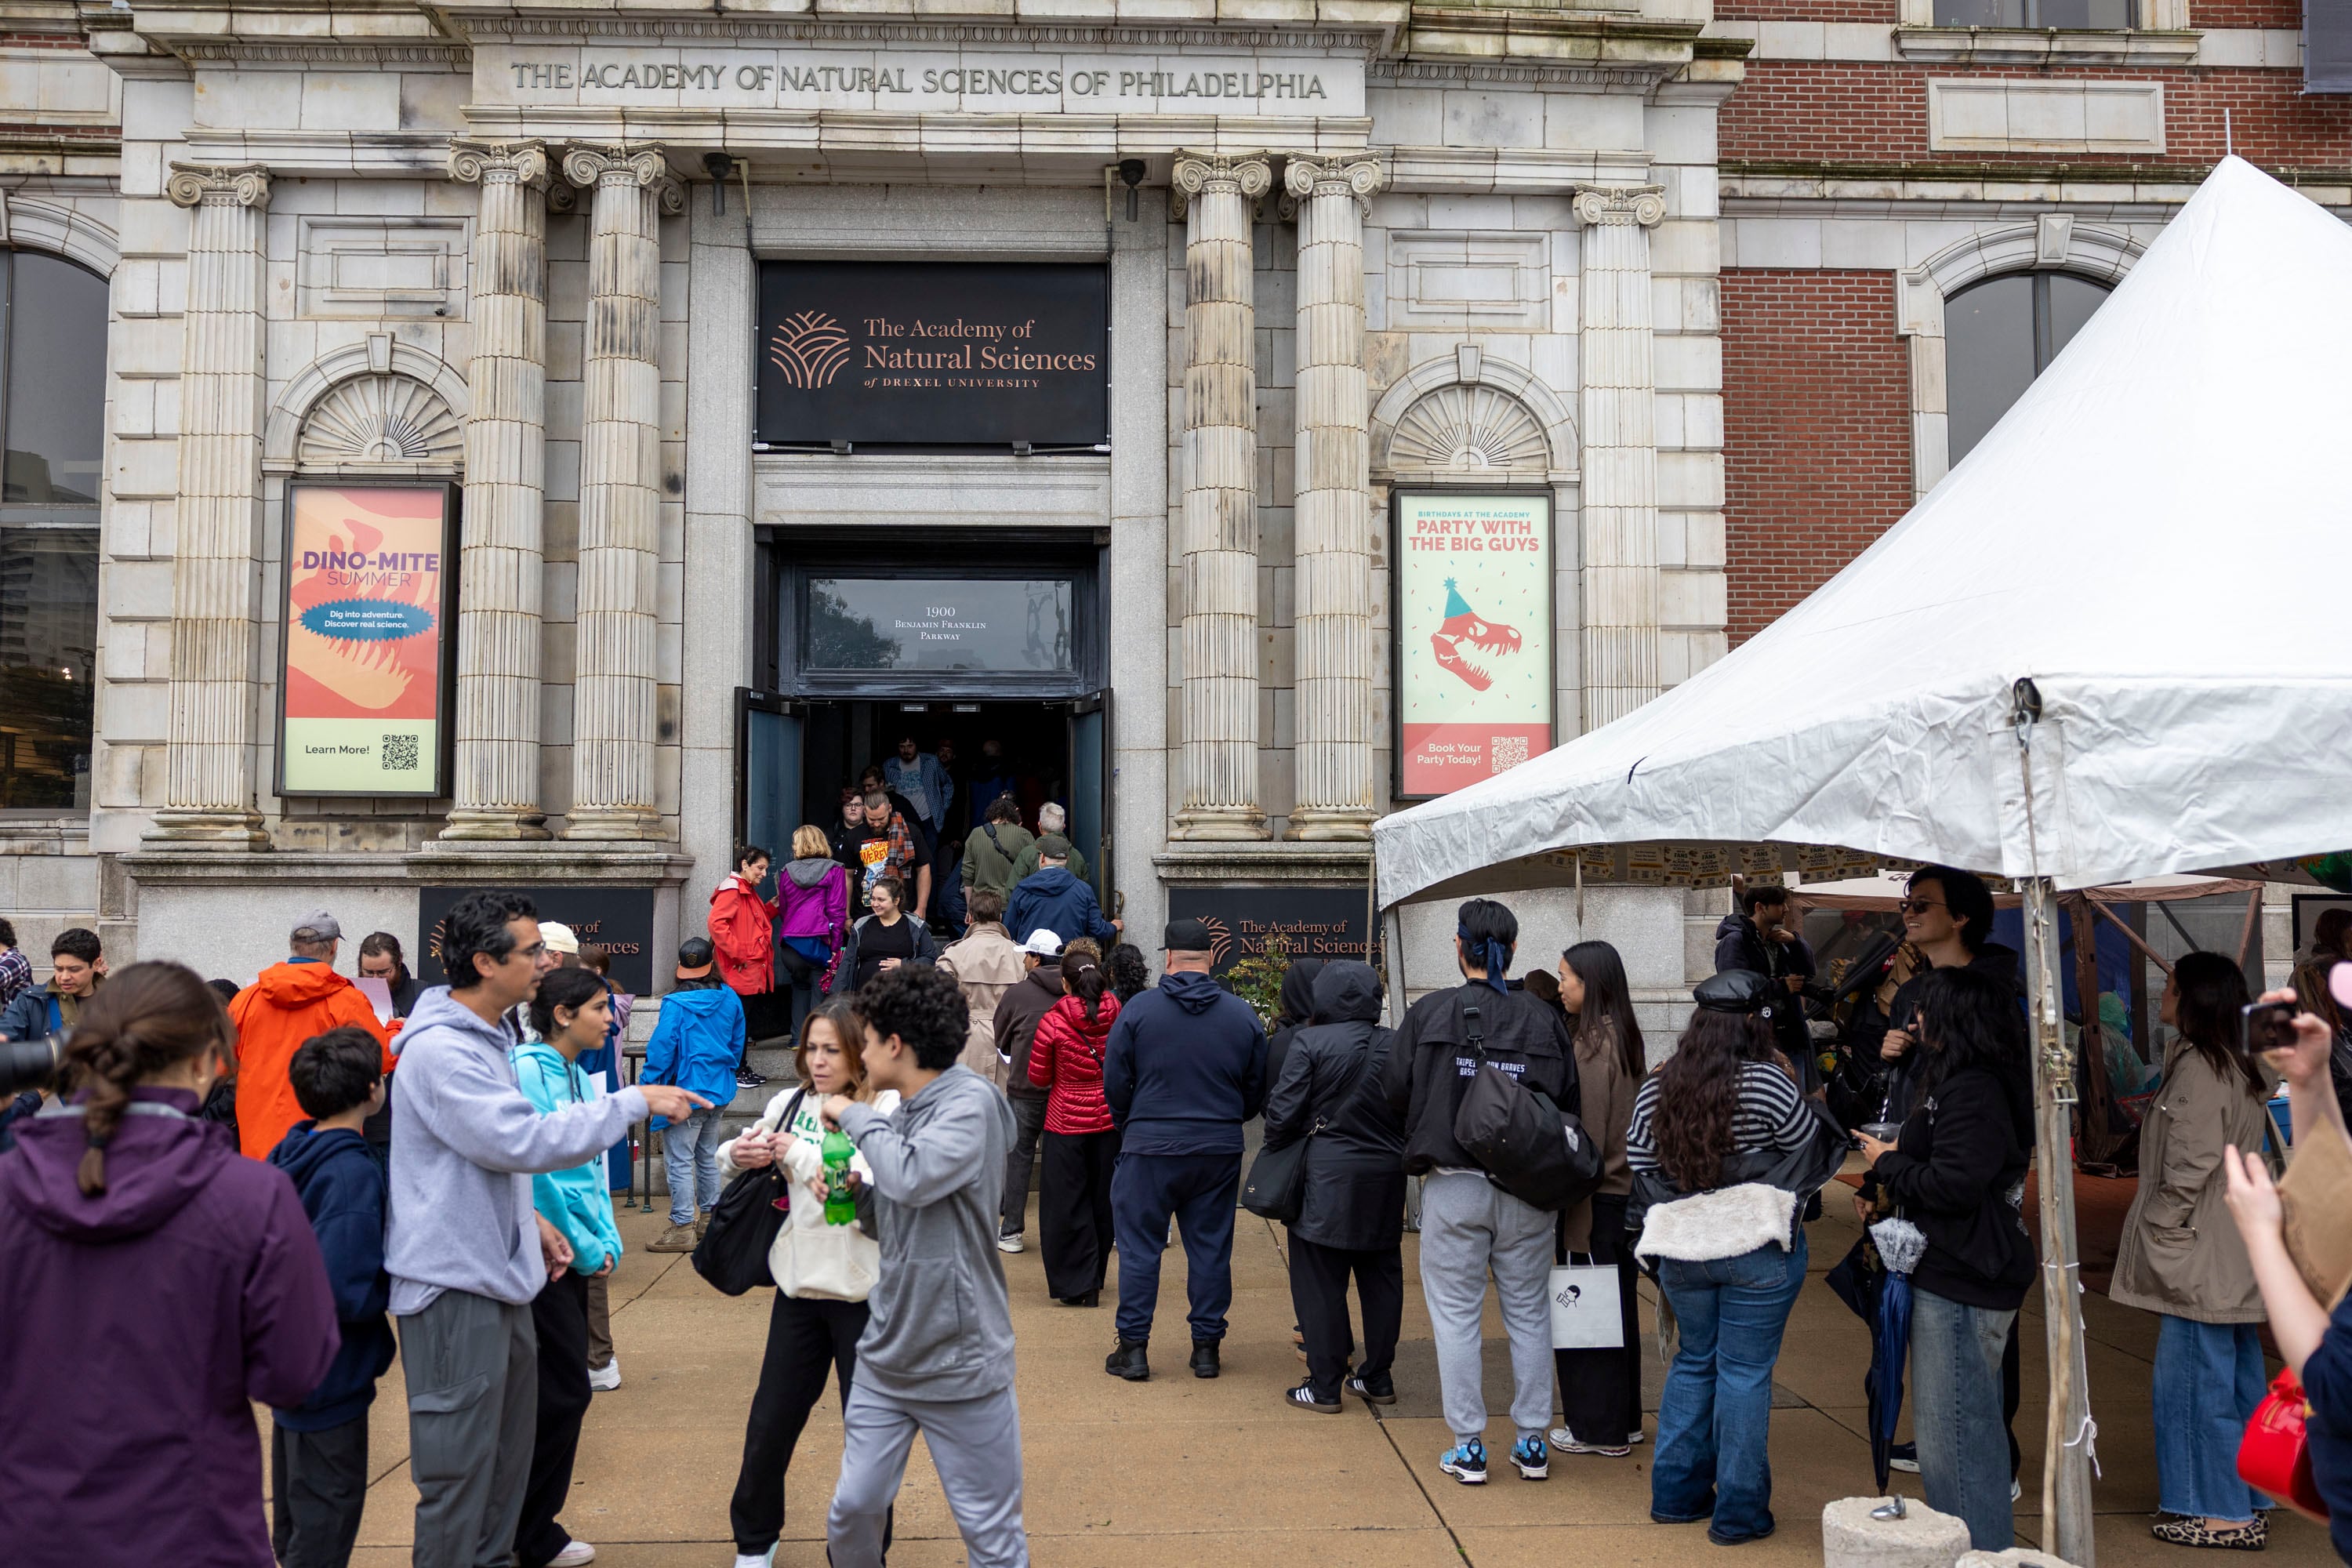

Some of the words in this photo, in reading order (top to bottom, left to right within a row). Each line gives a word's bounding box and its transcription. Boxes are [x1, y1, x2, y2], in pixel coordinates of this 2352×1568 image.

[510, 63, 573, 89] THE
[580, 63, 726, 89] ACADEMY
[735, 64, 775, 90] OF
[780, 66, 913, 93] NATURAL
[922, 68, 1062, 94] SCIENCES
[1070, 70, 1110, 96] OF
[1120, 71, 1327, 99] PHILADELPHIA
[864, 318, 904, 337] The
[909, 318, 1007, 343] Academy
[1011, 319, 1035, 338] of
[864, 344, 972, 369] Natural
[981, 346, 1095, 371] Sciences
[864, 378, 877, 388] of
[883, 378, 942, 387] DREXEL
[948, 379, 1040, 388] UNIVERSITY
[1417, 520, 1476, 534] PARTY
[1481, 521, 1531, 535] WITH
[1409, 536, 1445, 551] THE
[1451, 537, 1483, 552] BIG
[1488, 537, 1539, 552] GUYS
[303, 551, 439, 572] DINO-MITE
[327, 571, 412, 586] SUMMER
[330, 611, 343, 619] Dig
[926, 607, 956, 618] 1900
[306, 745, 336, 754] Learn
[339, 745, 369, 754] More!
[1428, 743, 1455, 753] Book
[1457, 744, 1481, 753] Your
[1417, 755, 1444, 766] Party
[1446, 755, 1481, 766] Today!
[585, 920, 601, 933] of
[1240, 920, 1265, 933] The
[1269, 920, 1330, 935] Academy
[1333, 920, 1348, 933] of
[1501, 1062, 1525, 1073] BRAVES
